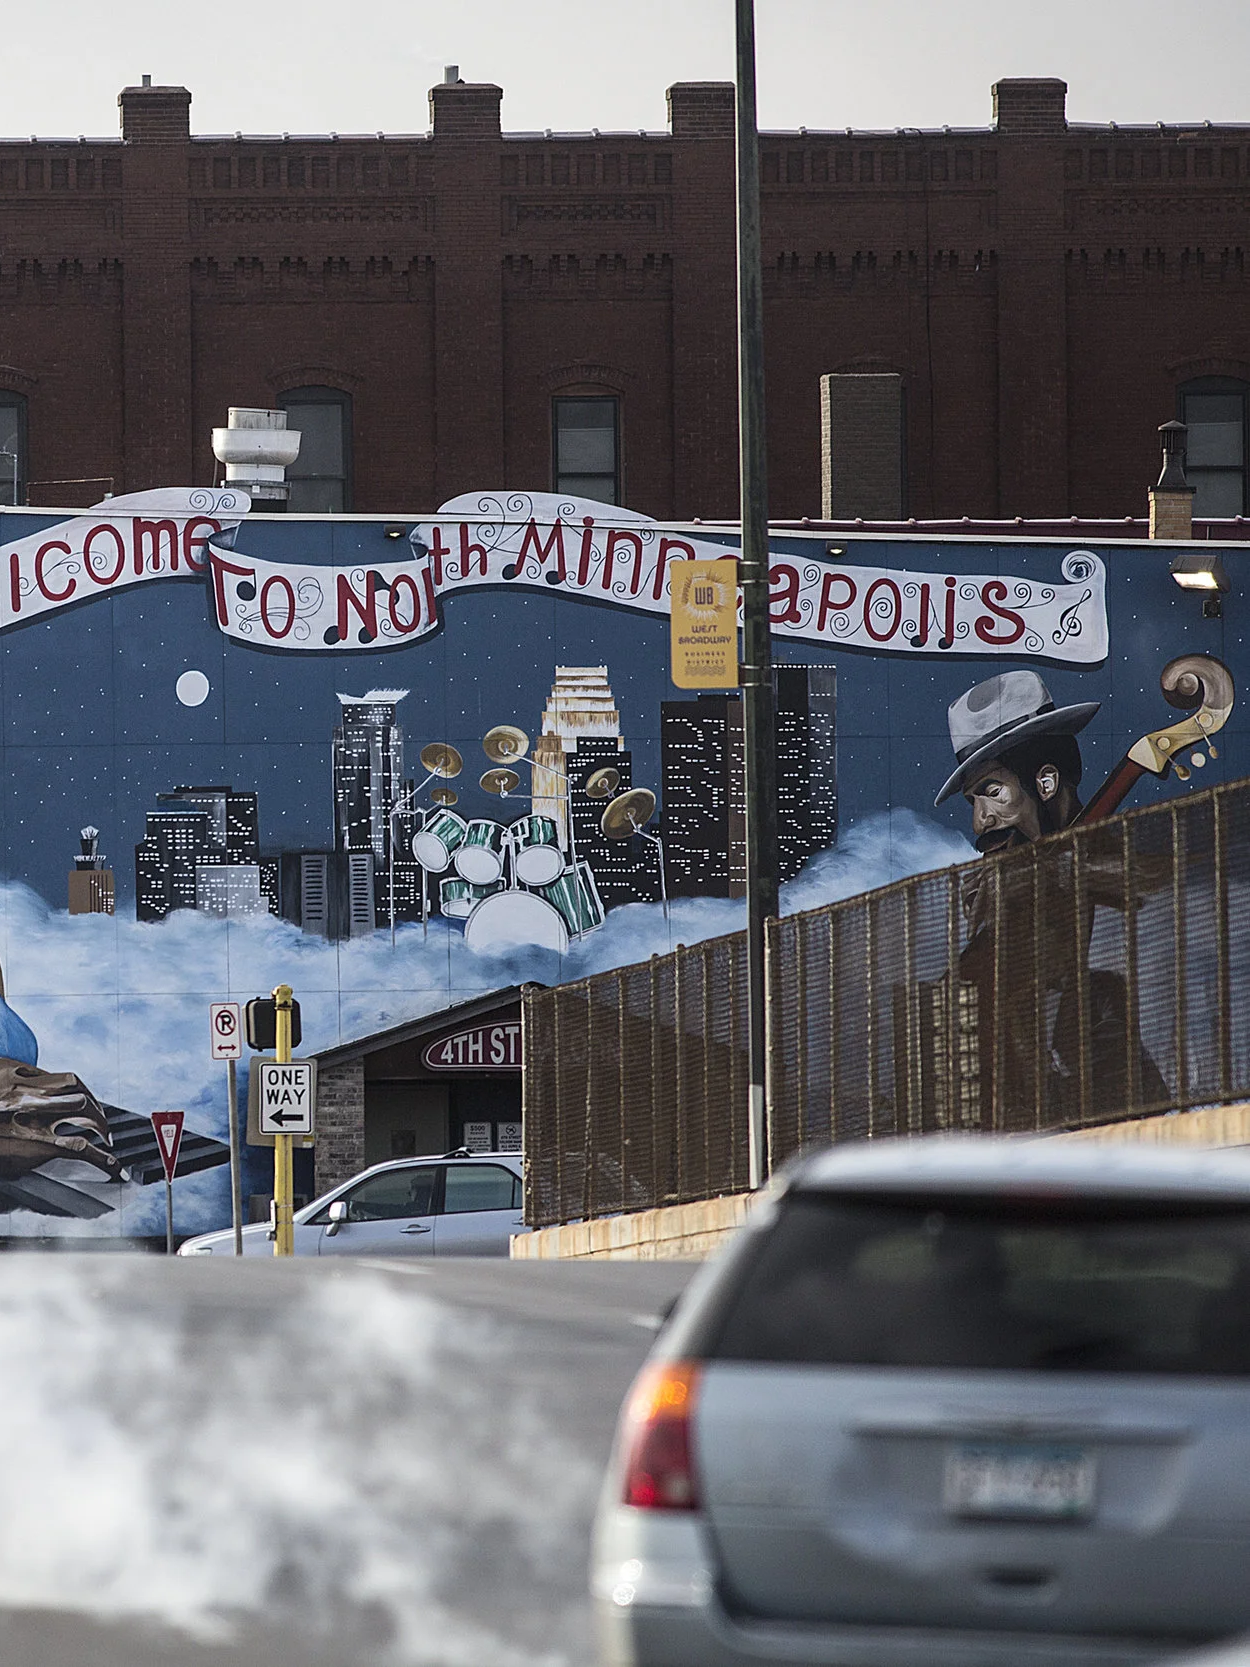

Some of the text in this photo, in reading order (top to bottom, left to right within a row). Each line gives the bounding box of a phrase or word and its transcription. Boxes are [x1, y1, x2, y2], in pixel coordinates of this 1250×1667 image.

[513, 516, 1027, 646] Minnapolis
[695, 586, 714, 605] WB
[691, 624, 718, 634] WEST
[678, 636, 732, 645] BROADWAY
[441, 1031, 484, 1064] 4TH
[268, 1069, 305, 1086] ONE
[266, 1089, 306, 1105] WAY
